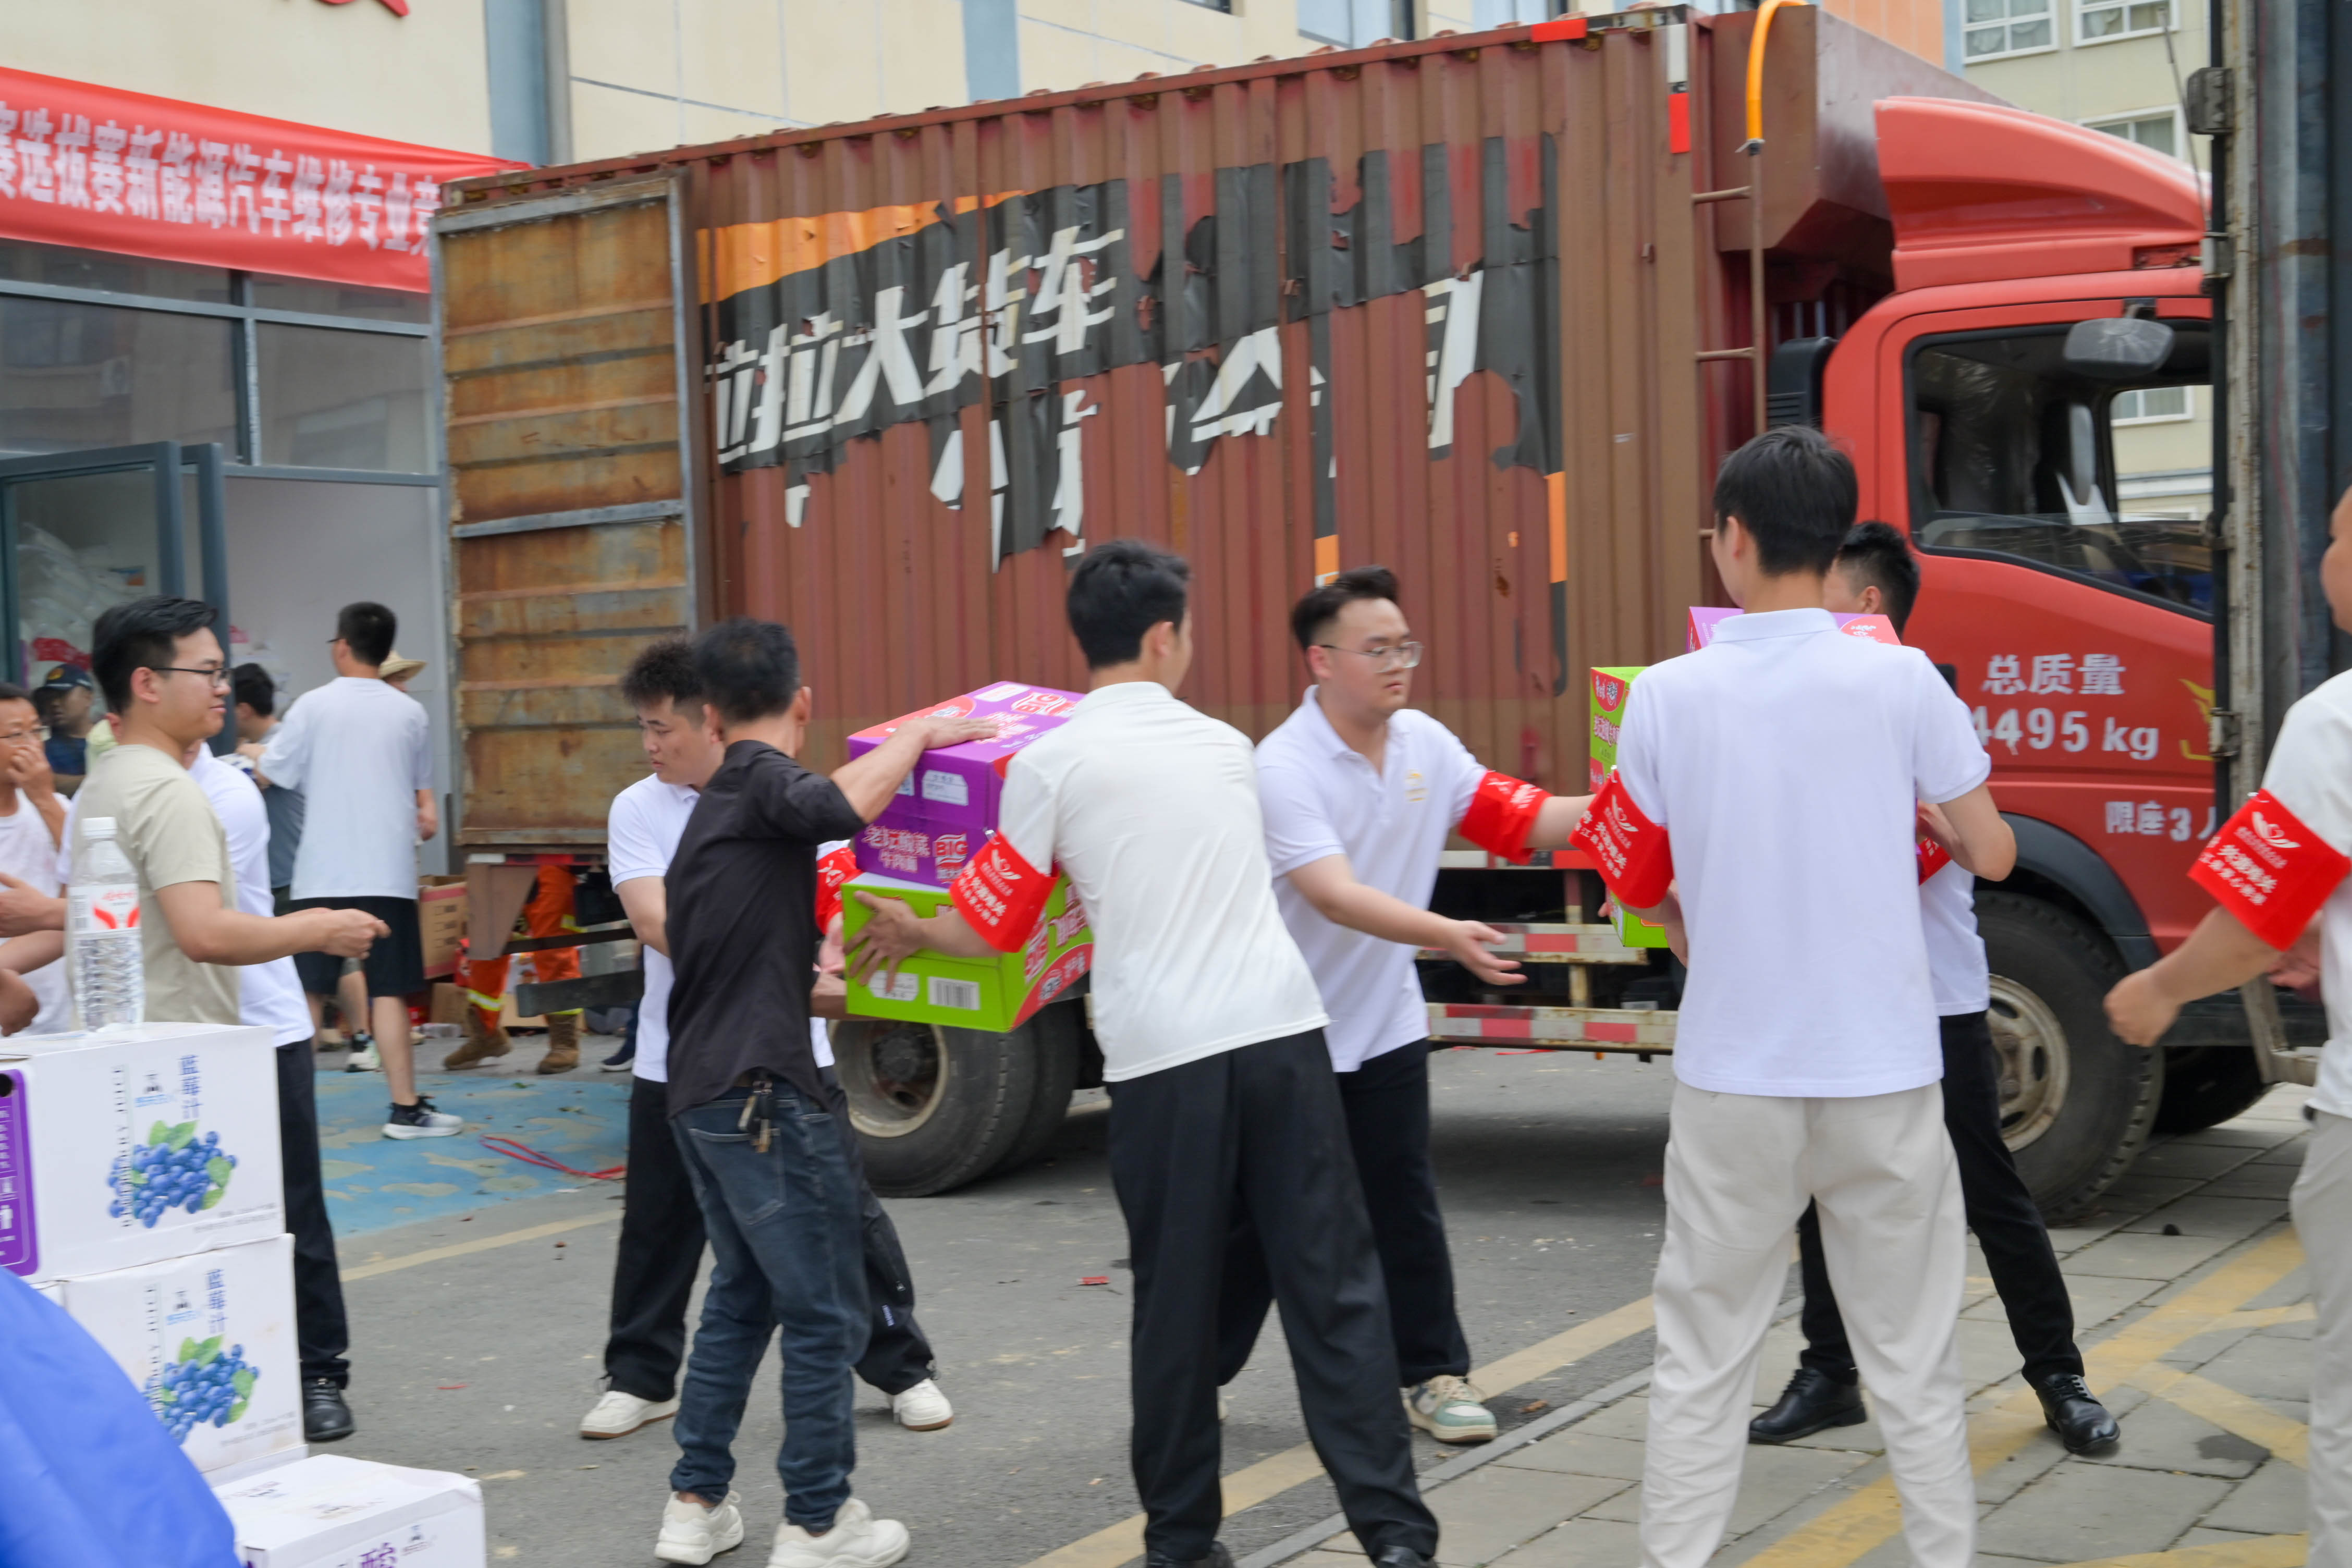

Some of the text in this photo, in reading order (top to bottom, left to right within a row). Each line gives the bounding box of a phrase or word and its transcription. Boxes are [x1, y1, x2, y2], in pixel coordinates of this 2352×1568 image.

[1980, 653, 2126, 695] 总质量
[2102, 717, 2159, 760] kg
[935, 840, 968, 856] BIG
